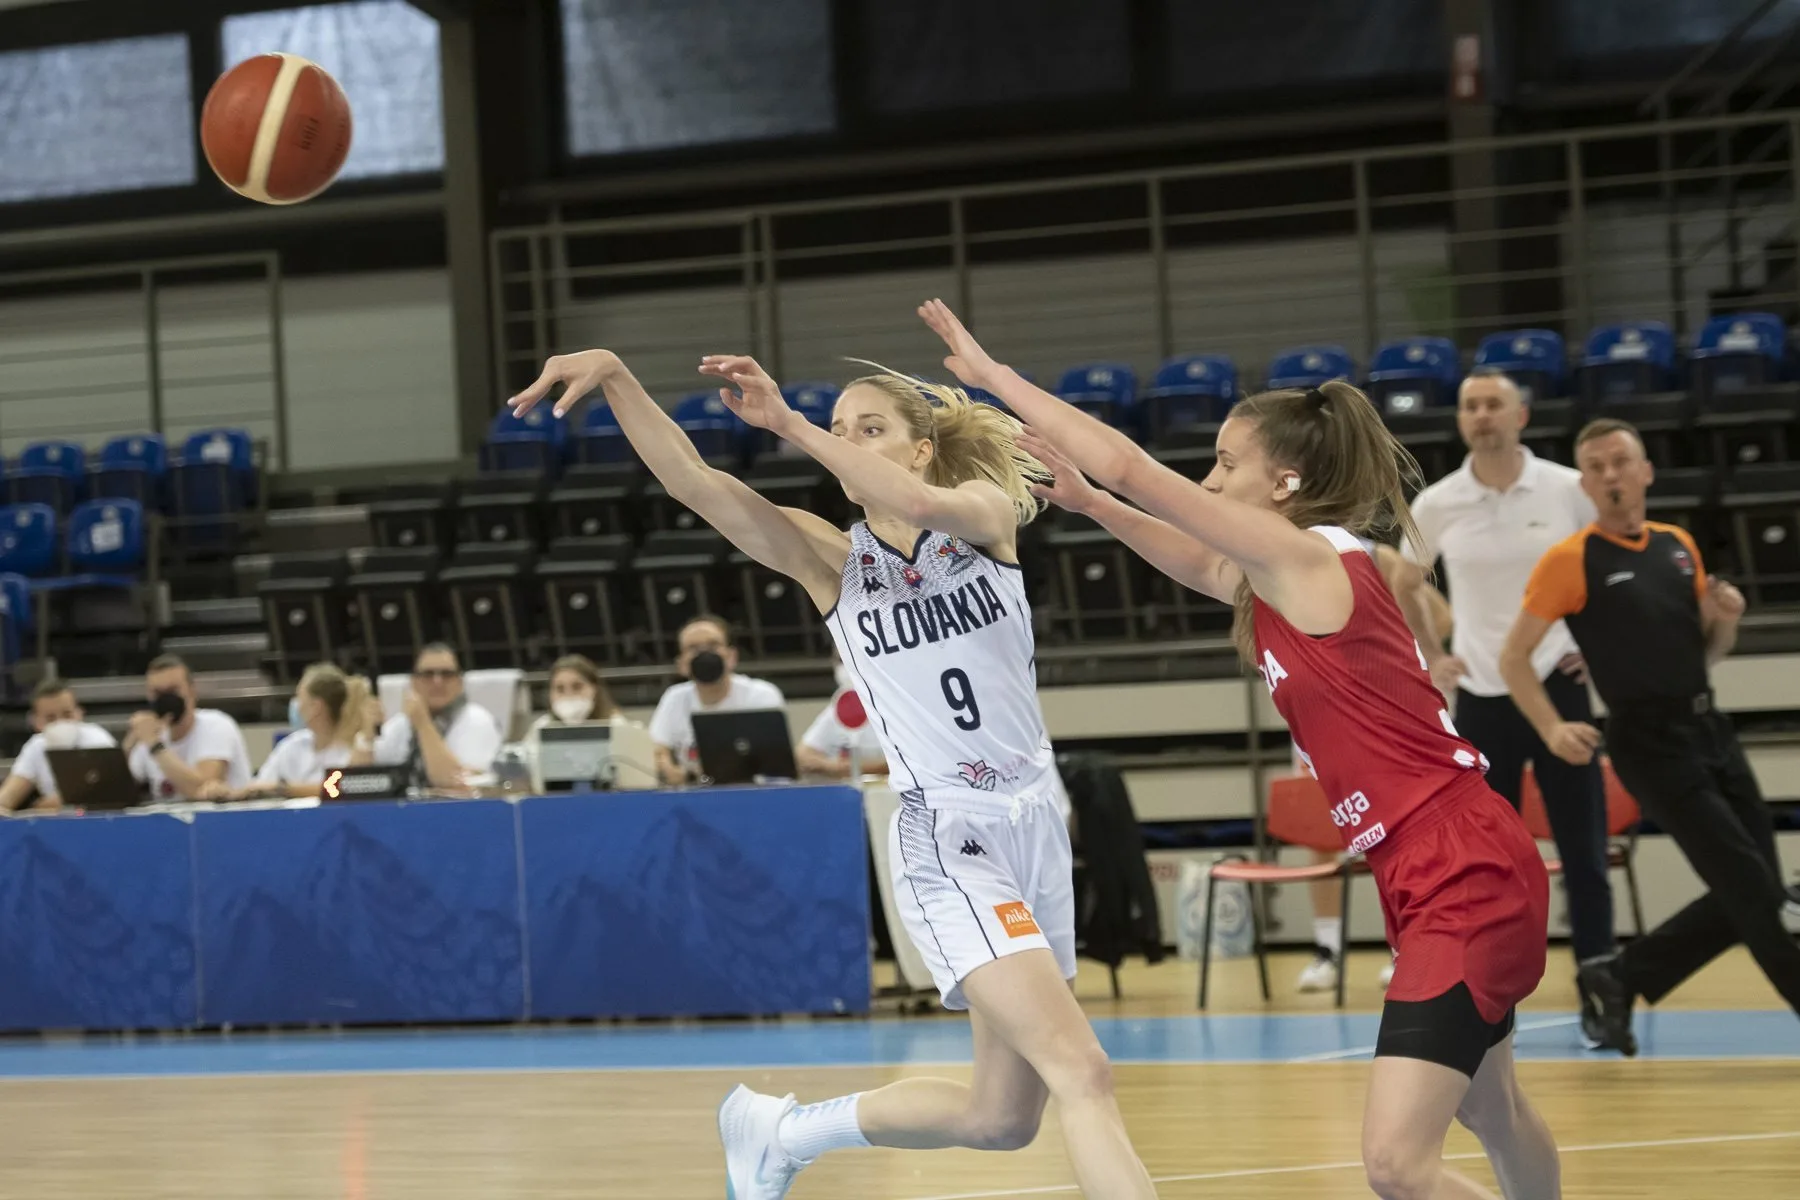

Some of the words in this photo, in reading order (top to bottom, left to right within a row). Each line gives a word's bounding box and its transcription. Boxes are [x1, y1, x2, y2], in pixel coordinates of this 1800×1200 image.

[857, 575, 1008, 658] SLOVAKIA
[940, 667, 981, 731] 9
[1330, 790, 1371, 827] erga
[1354, 826, 1384, 852] ORLEN
